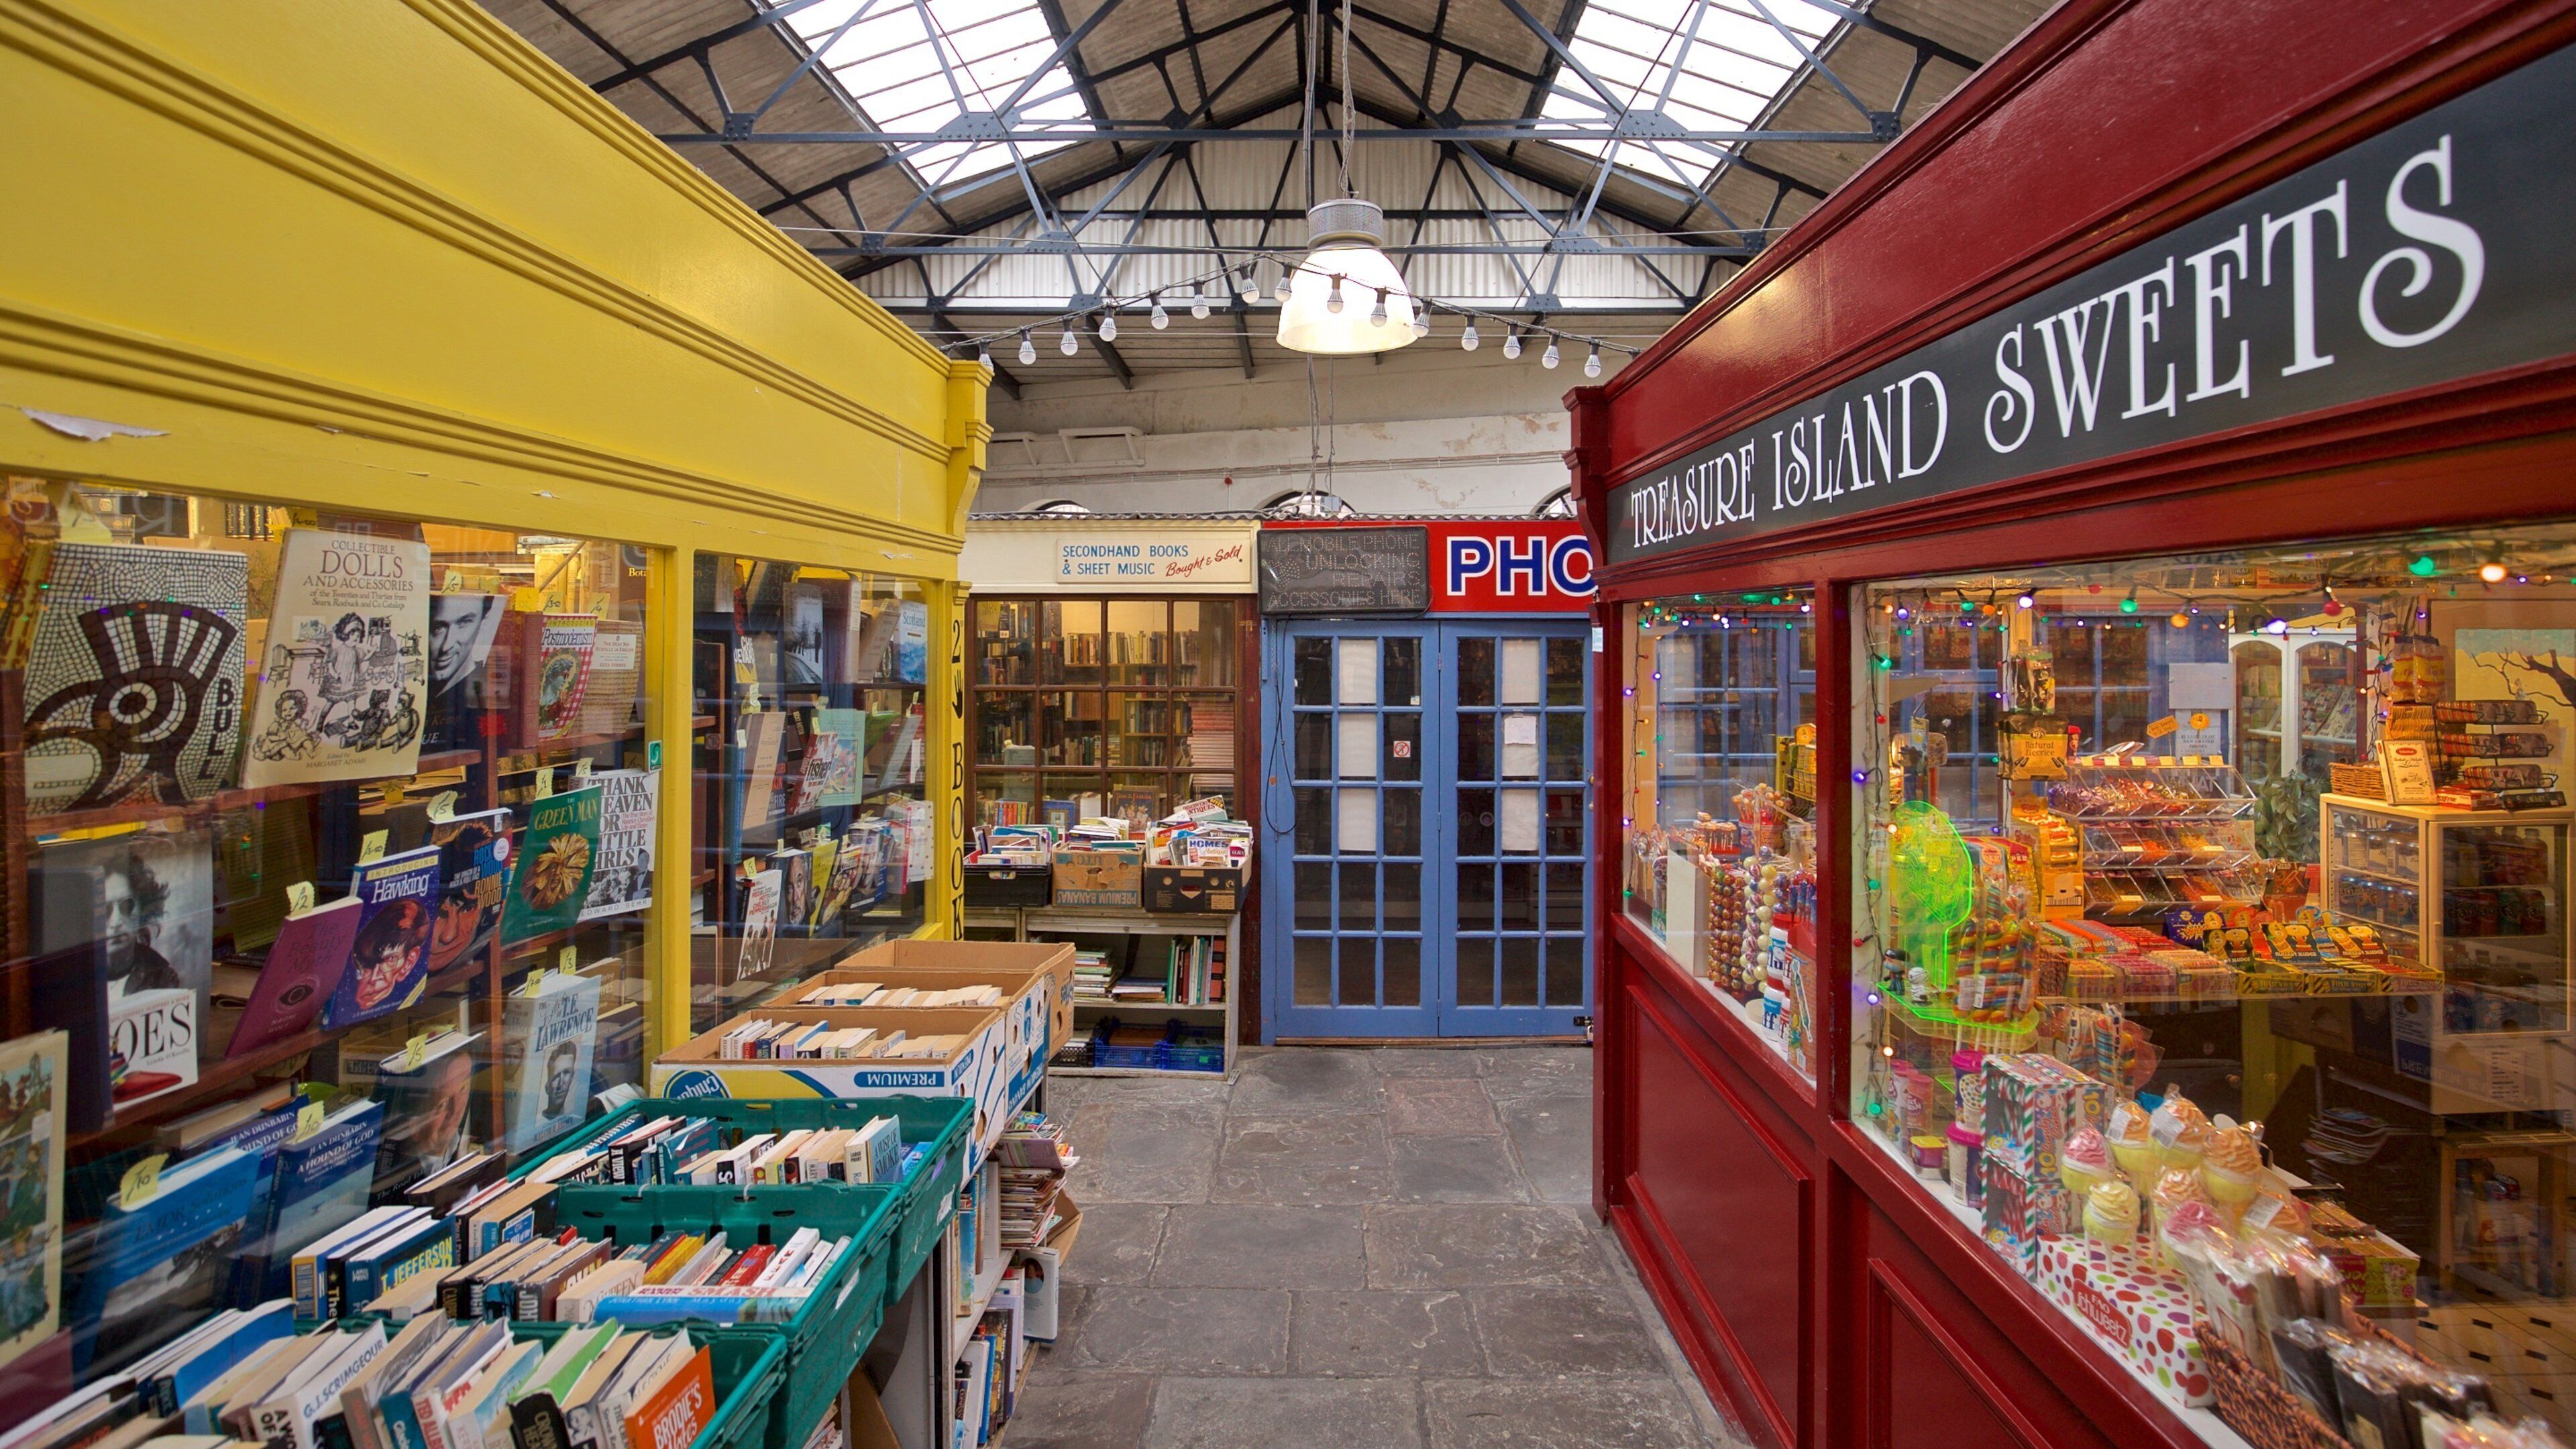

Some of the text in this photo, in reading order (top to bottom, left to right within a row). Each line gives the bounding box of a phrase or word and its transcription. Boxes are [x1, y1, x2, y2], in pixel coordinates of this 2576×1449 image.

[1631, 136, 2486, 549] TREASURE ISLAND SWEETS
[331, 540, 396, 555] COLLECTIBLE
[1063, 545, 1189, 557] SECONDHAND BOOKS
[1362, 535, 1420, 551] PHONE
[320, 549, 403, 579] DOLLS
[1063, 562, 1155, 575] & SHEET MUSIC
[1165, 555, 1205, 578] Bought
[1214, 545, 1243, 562] Sold
[1304, 553, 1420, 571] UNLOCKING
[303, 576, 413, 592] AND ACCESSORIES
[548, 619, 594, 627] INTRODUCING
[902, 611, 926, 629] Scotland
[542, 629, 594, 646] Postmodernism
[2025, 741, 2055, 749] Natural
[2025, 749, 2055, 757] Licorice
[601, 793, 653, 814] EAVEN
[534, 797, 598, 832] GREEN MAN
[599, 828, 646, 851] ITTLE
[1189, 839, 1230, 848] HOMES
[370, 857, 435, 878] INTRODUCING
[594, 847, 635, 871] IRLS
[371, 873, 430, 904] Hawking
[475, 871, 503, 897] RONNIE
[477, 888, 502, 910] WOOD
[581, 898, 648, 918] EDWARD BEHR
[1057, 891, 1137, 905] PREMIUM BANANAS
[535, 1007, 595, 1053] LAWRENCE
[867, 1073, 937, 1087] PREMIUM
[230, 1110, 296, 1144] JEAN DUNBABIN
[306, 1146, 341, 1171] HOUND
[341, 1140, 354, 1153] OF
[354, 1128, 374, 1145] GOD
[309, 1120, 368, 1158] JEAN DUNBABIN
[879, 1136, 891, 1152] WISP
[891, 1129, 898, 1144] OF
[849, 1150, 861, 1158] LARGE
[875, 1147, 899, 1182] SMOKE
[393, 1236, 453, 1288] JEFFERSON
[352, 1275, 369, 1283] PRINT
[689, 1287, 777, 1297] SMASH
[2091, 1293, 2110, 1315] FAO
[323, 1339, 384, 1401] SCRIMGEOUR
[653, 1382, 702, 1449] BRODIE'S
